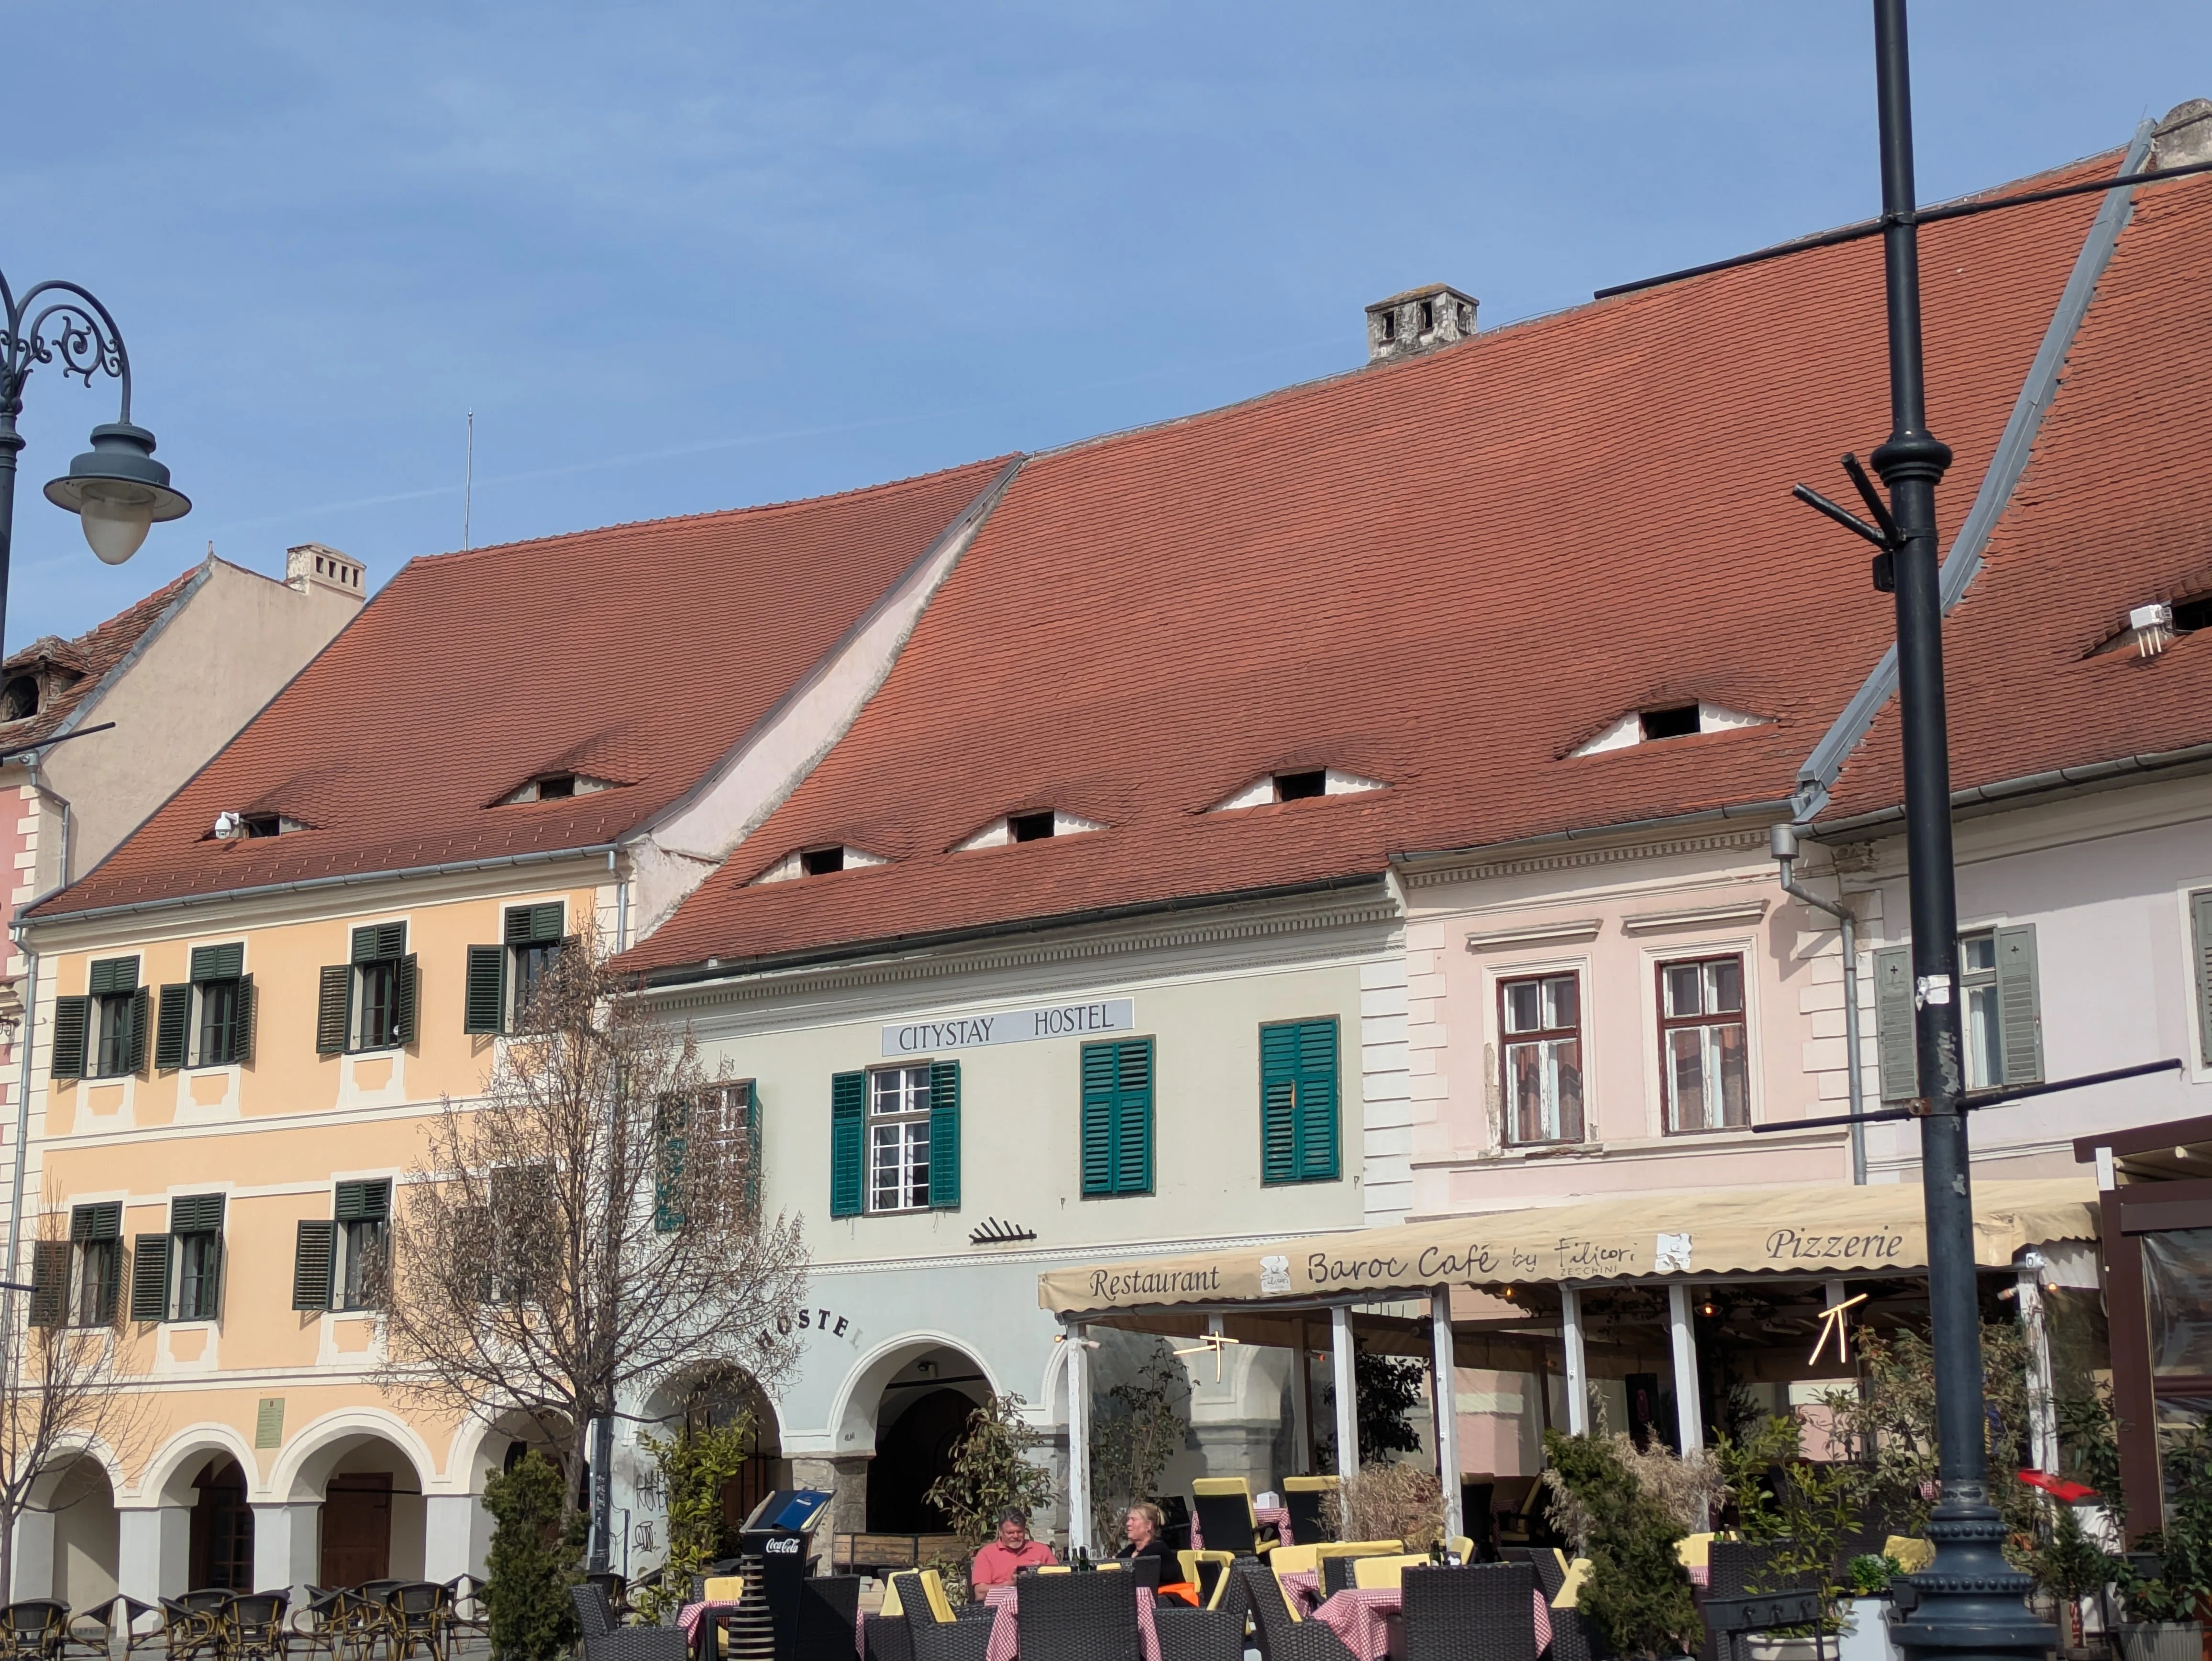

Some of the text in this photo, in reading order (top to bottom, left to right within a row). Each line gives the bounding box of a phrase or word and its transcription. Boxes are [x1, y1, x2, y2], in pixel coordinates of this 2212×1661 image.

[899, 1004, 1114, 1050] CITYSTAY HOSTEL
[1766, 1225, 1902, 1258] Pizzerie
[1308, 1237, 1637, 1283] Baroc Café by Filicori
[1560, 1265, 1617, 1276] ZECCHINI
[1090, 1266, 1220, 1301] Restaurant
